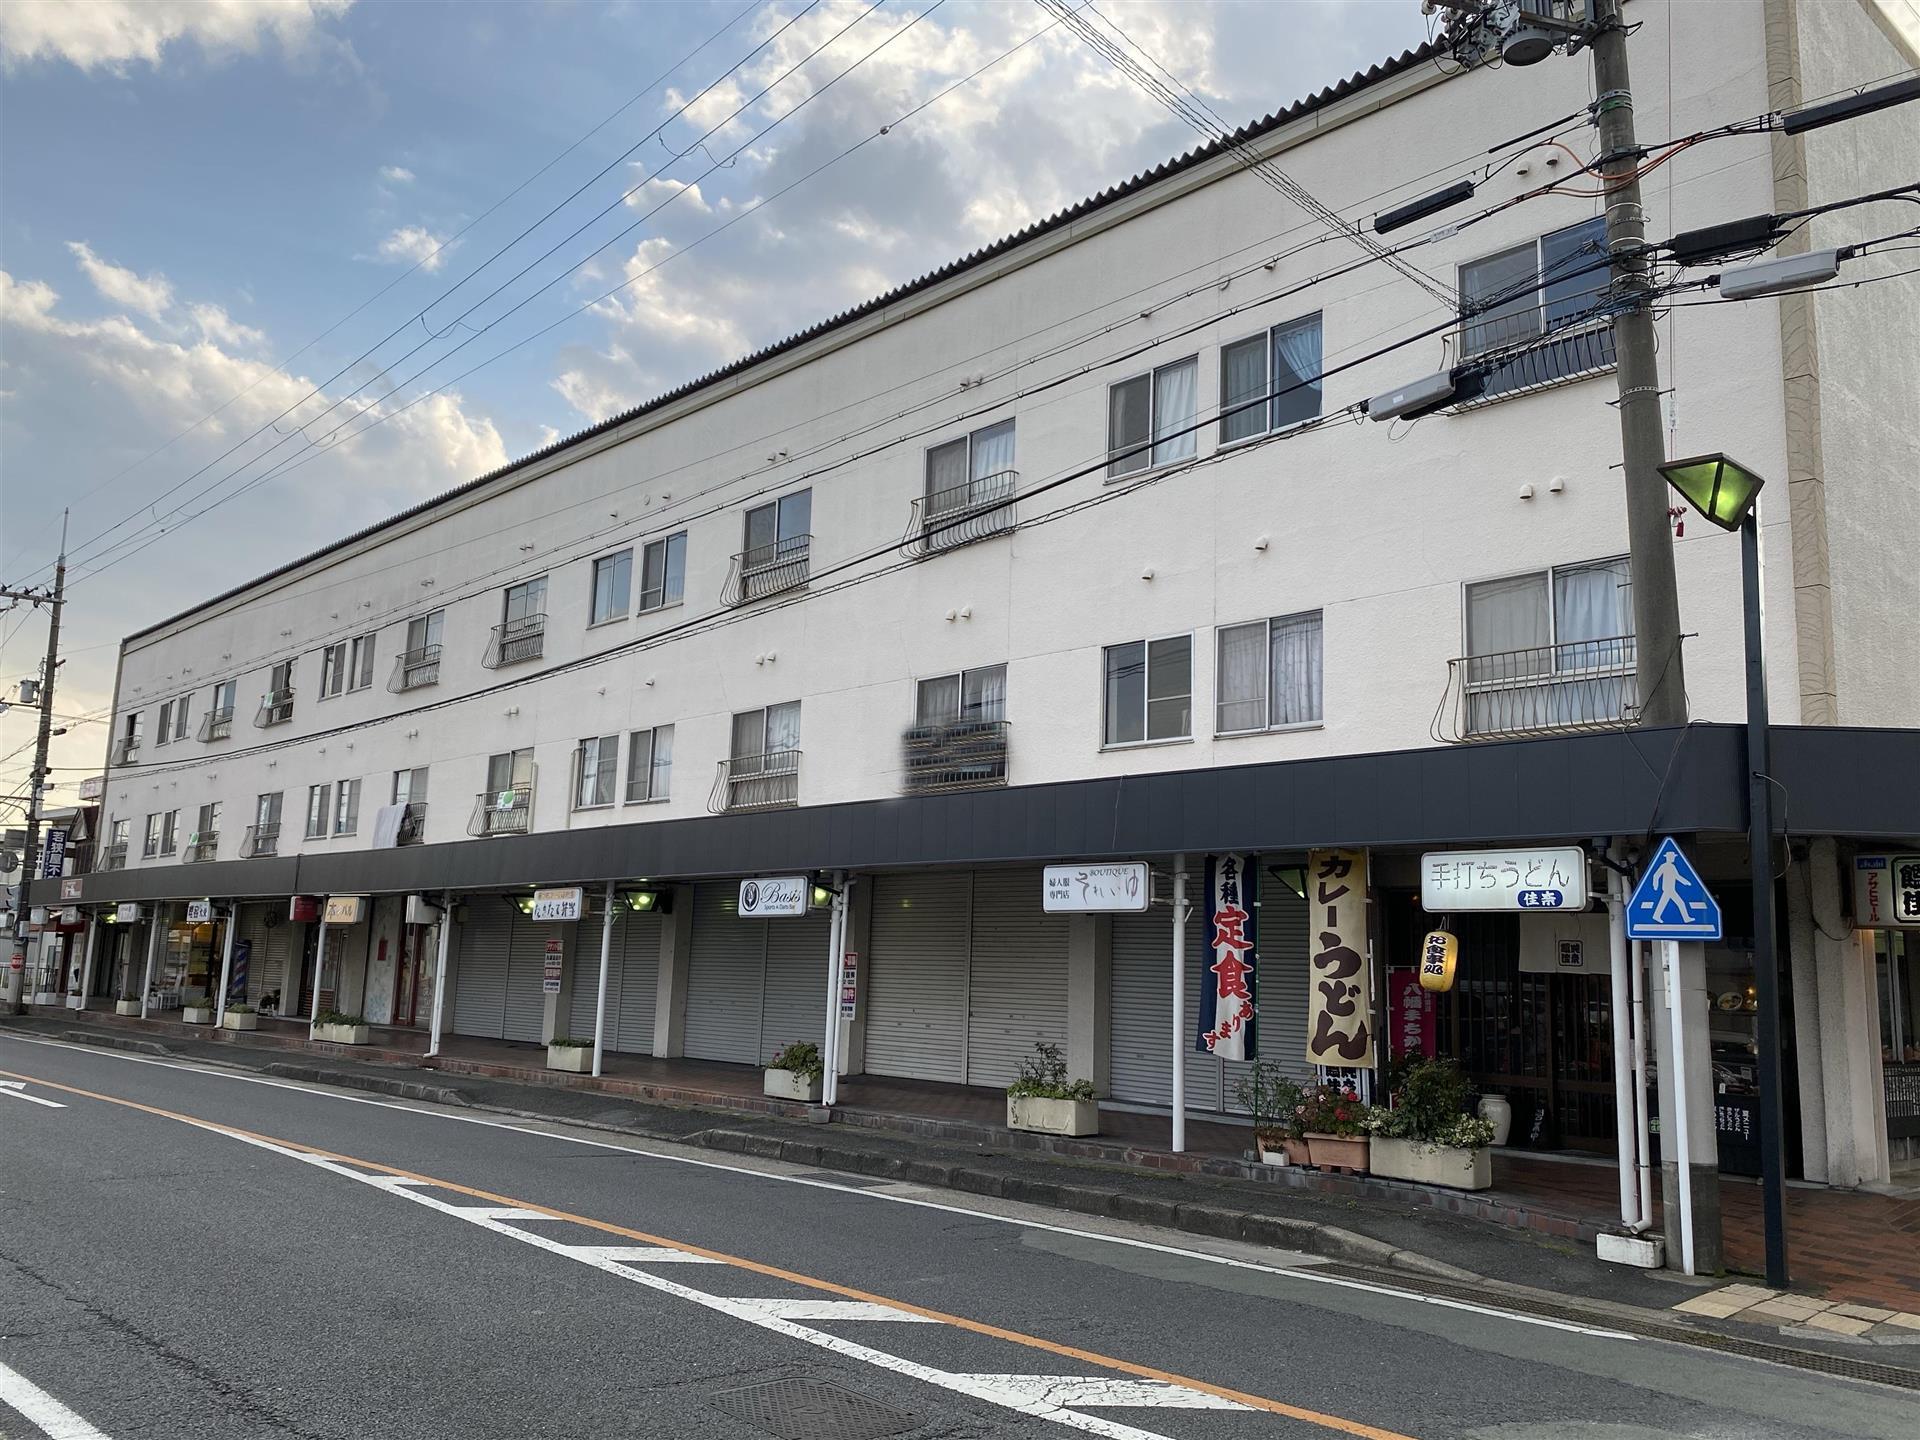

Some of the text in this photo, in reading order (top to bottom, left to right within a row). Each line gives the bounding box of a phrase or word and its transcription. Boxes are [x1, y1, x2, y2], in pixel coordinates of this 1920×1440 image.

[48, 831, 65, 879] 若狭屋不
[1049, 878, 1070, 887] 婦人服
[1089, 867, 1129, 877] BOUTIQUE
[1432, 859, 1569, 889] 手打ちうどん
[761, 881, 802, 903] Basis
[1049, 890, 1070, 900] 専門店
[1868, 872, 1880, 922] アサヒビール
[1311, 855, 1368, 1060] カレーうどん
[1424, 935, 1447, 976] お食事処
